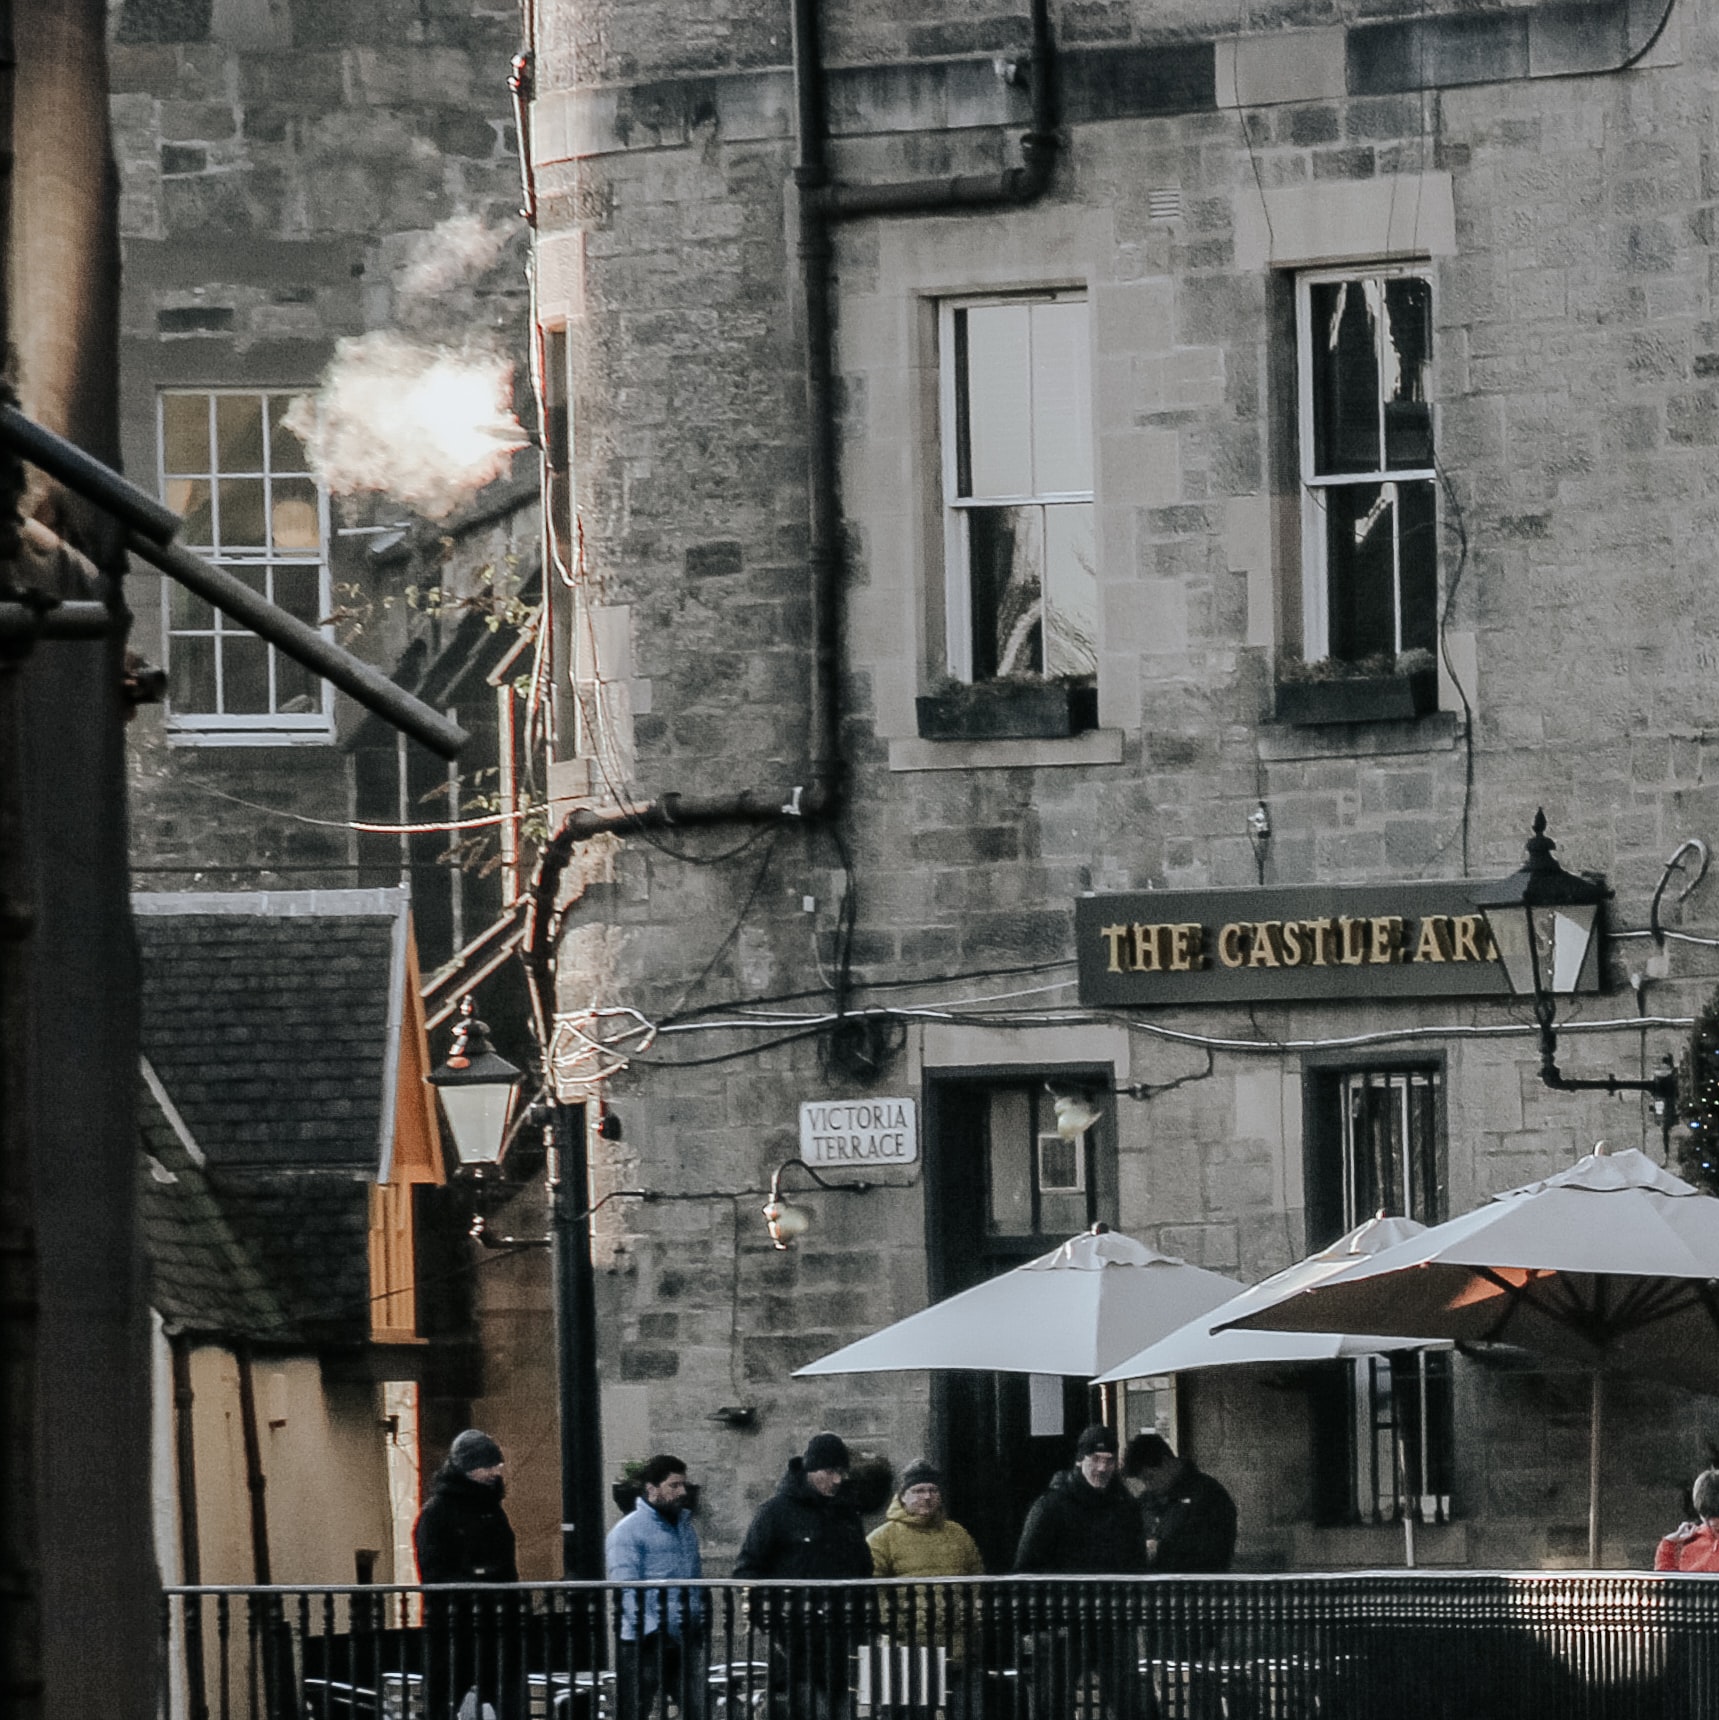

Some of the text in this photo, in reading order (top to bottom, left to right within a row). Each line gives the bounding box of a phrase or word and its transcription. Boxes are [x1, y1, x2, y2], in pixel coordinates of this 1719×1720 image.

[1101, 922, 1202, 974] THE
[1217, 914, 1403, 968] CASTLE
[807, 1104, 908, 1131] VICTORIA
[812, 1133, 905, 1160] TERRACE
